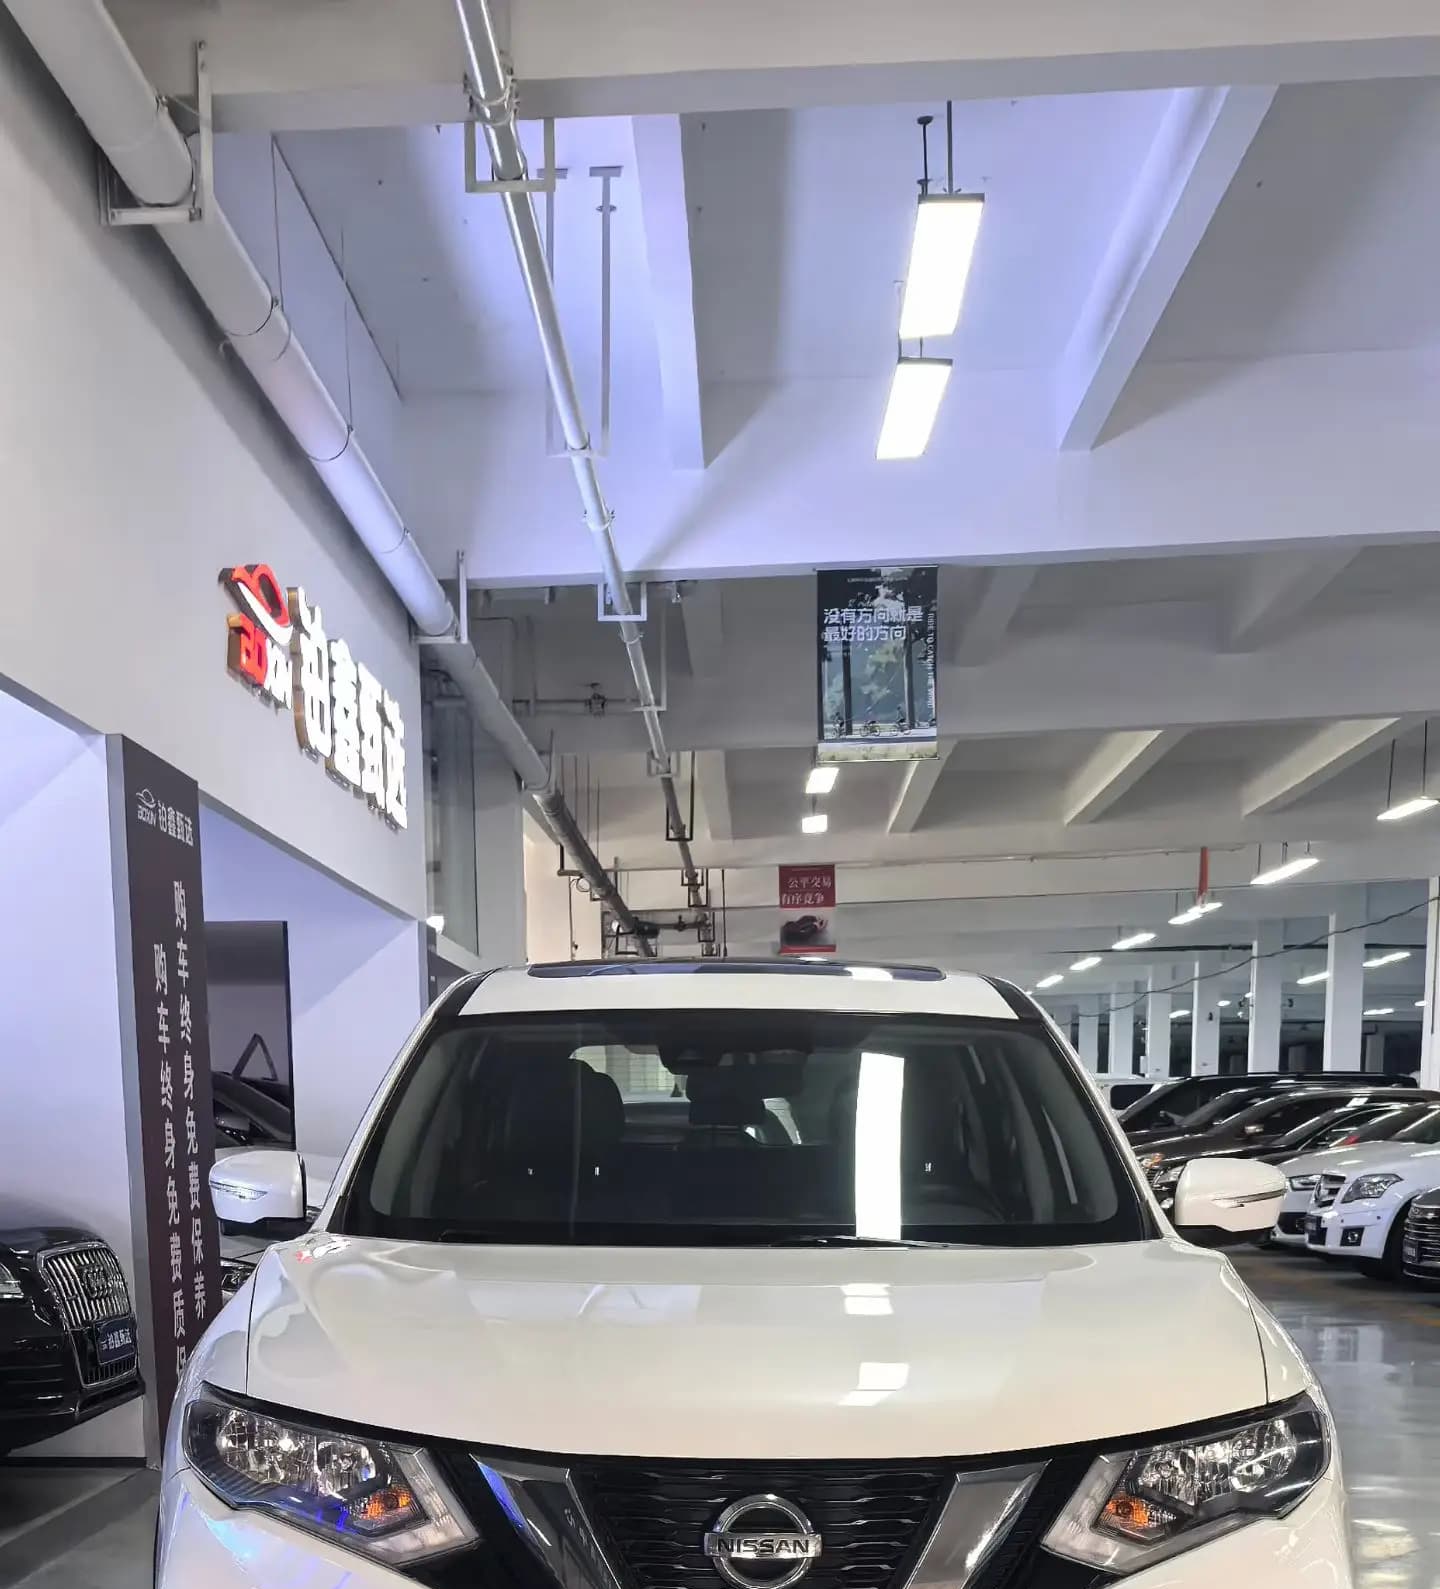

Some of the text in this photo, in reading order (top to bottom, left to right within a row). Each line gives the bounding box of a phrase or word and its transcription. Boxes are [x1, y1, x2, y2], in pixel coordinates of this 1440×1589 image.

[823, 606, 923, 624] 没有方向就是
[823, 625, 906, 642] 最好的方向
[297, 587, 407, 828] 铂鑫甄选
[158, 800, 194, 846] 铂鑫甄选
[174, 881, 206, 1320] 购车终身免费保养
[717, 1538, 809, 1553] NISSAN
